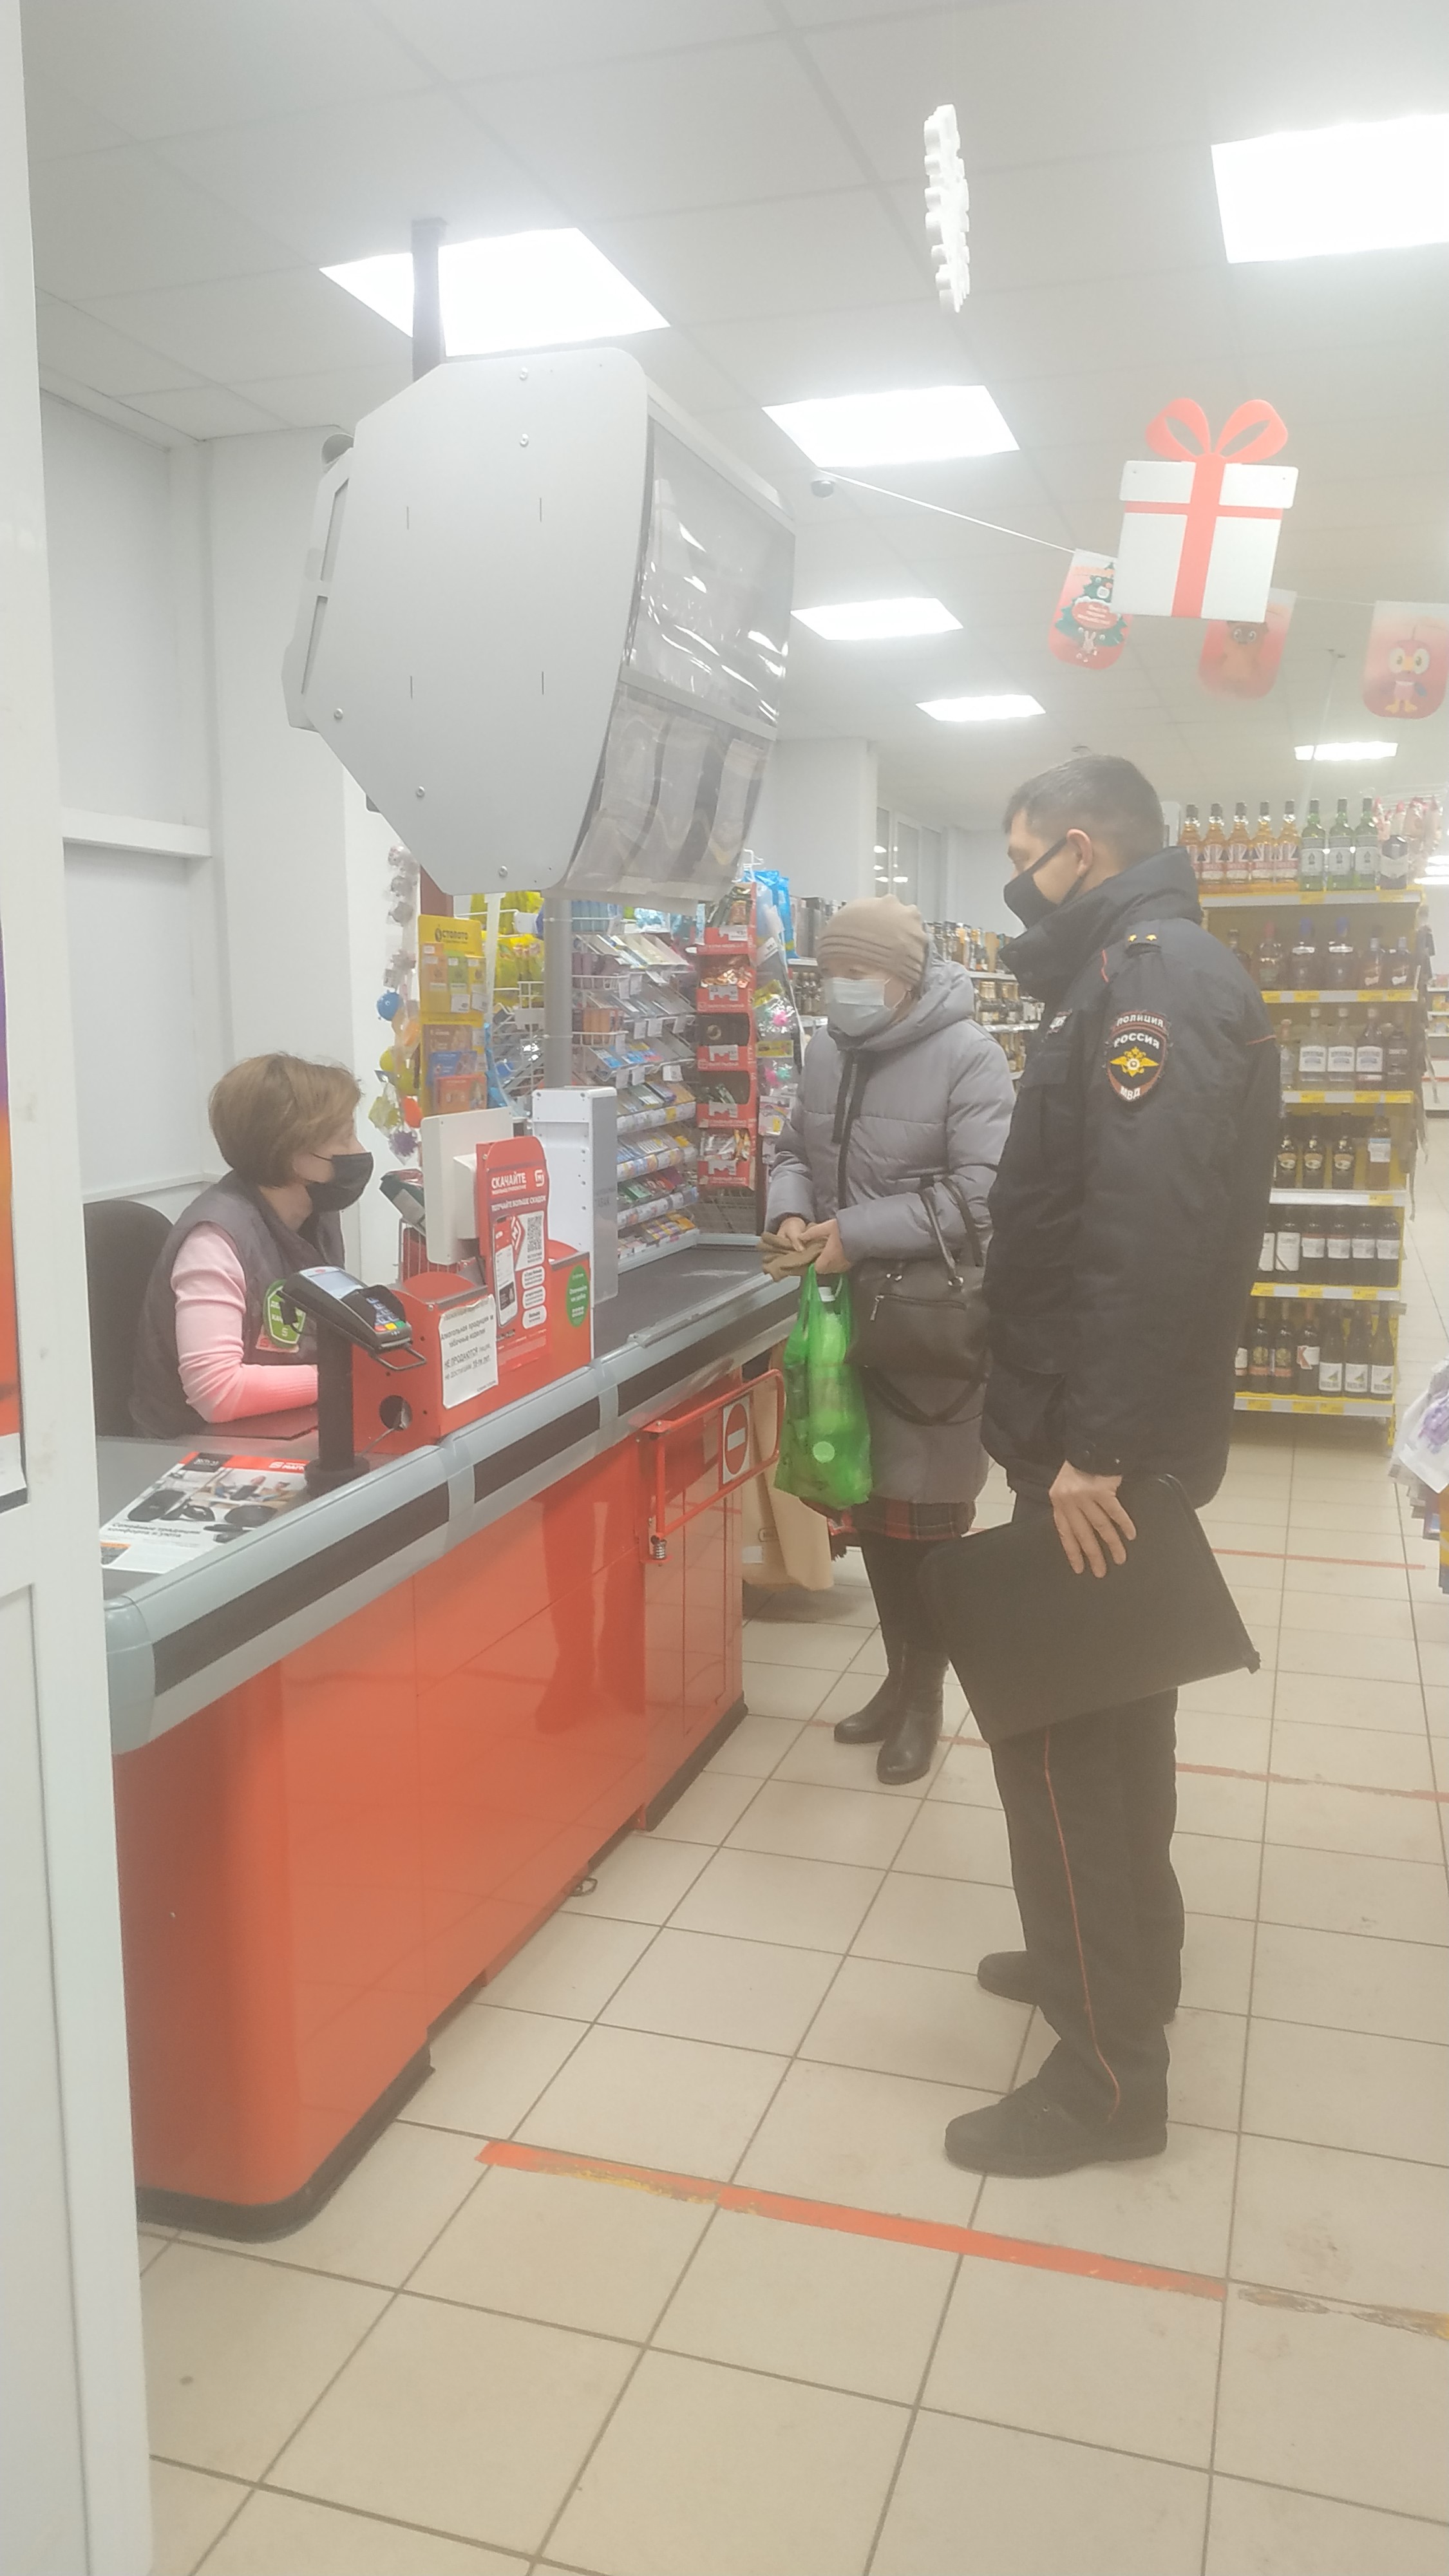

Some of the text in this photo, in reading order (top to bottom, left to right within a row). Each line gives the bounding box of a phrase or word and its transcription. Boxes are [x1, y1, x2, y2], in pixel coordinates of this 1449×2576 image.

[1117, 1014, 1164, 1028] ПОЛИЦИЯ
[1114, 1032, 1160, 1050] РОССИЯ
[1120, 1085, 1141, 1101] МВД
[491, 1171, 527, 1189] СКАЧАЙТЕ
[108, 1528, 150, 1536] комфорта
[112, 1522, 156, 1531] Семейные
